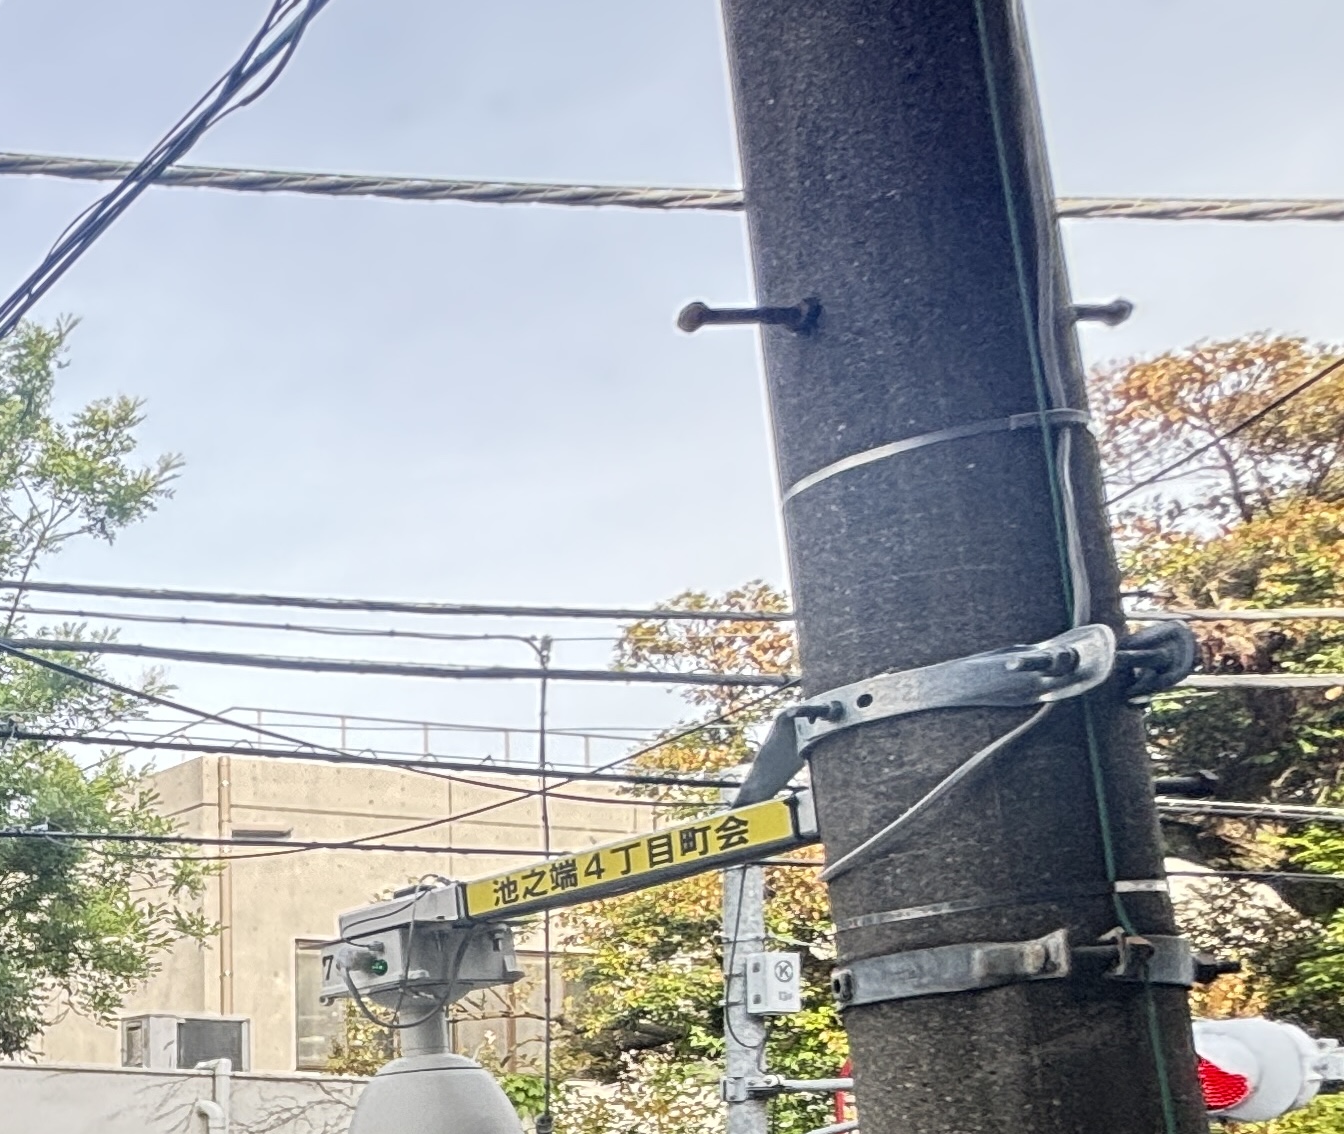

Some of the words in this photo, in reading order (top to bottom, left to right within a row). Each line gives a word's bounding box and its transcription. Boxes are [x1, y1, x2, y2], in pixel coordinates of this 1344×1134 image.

[493, 815, 750, 907] 池之端4丁目町会
[322, 954, 334, 981] 7
